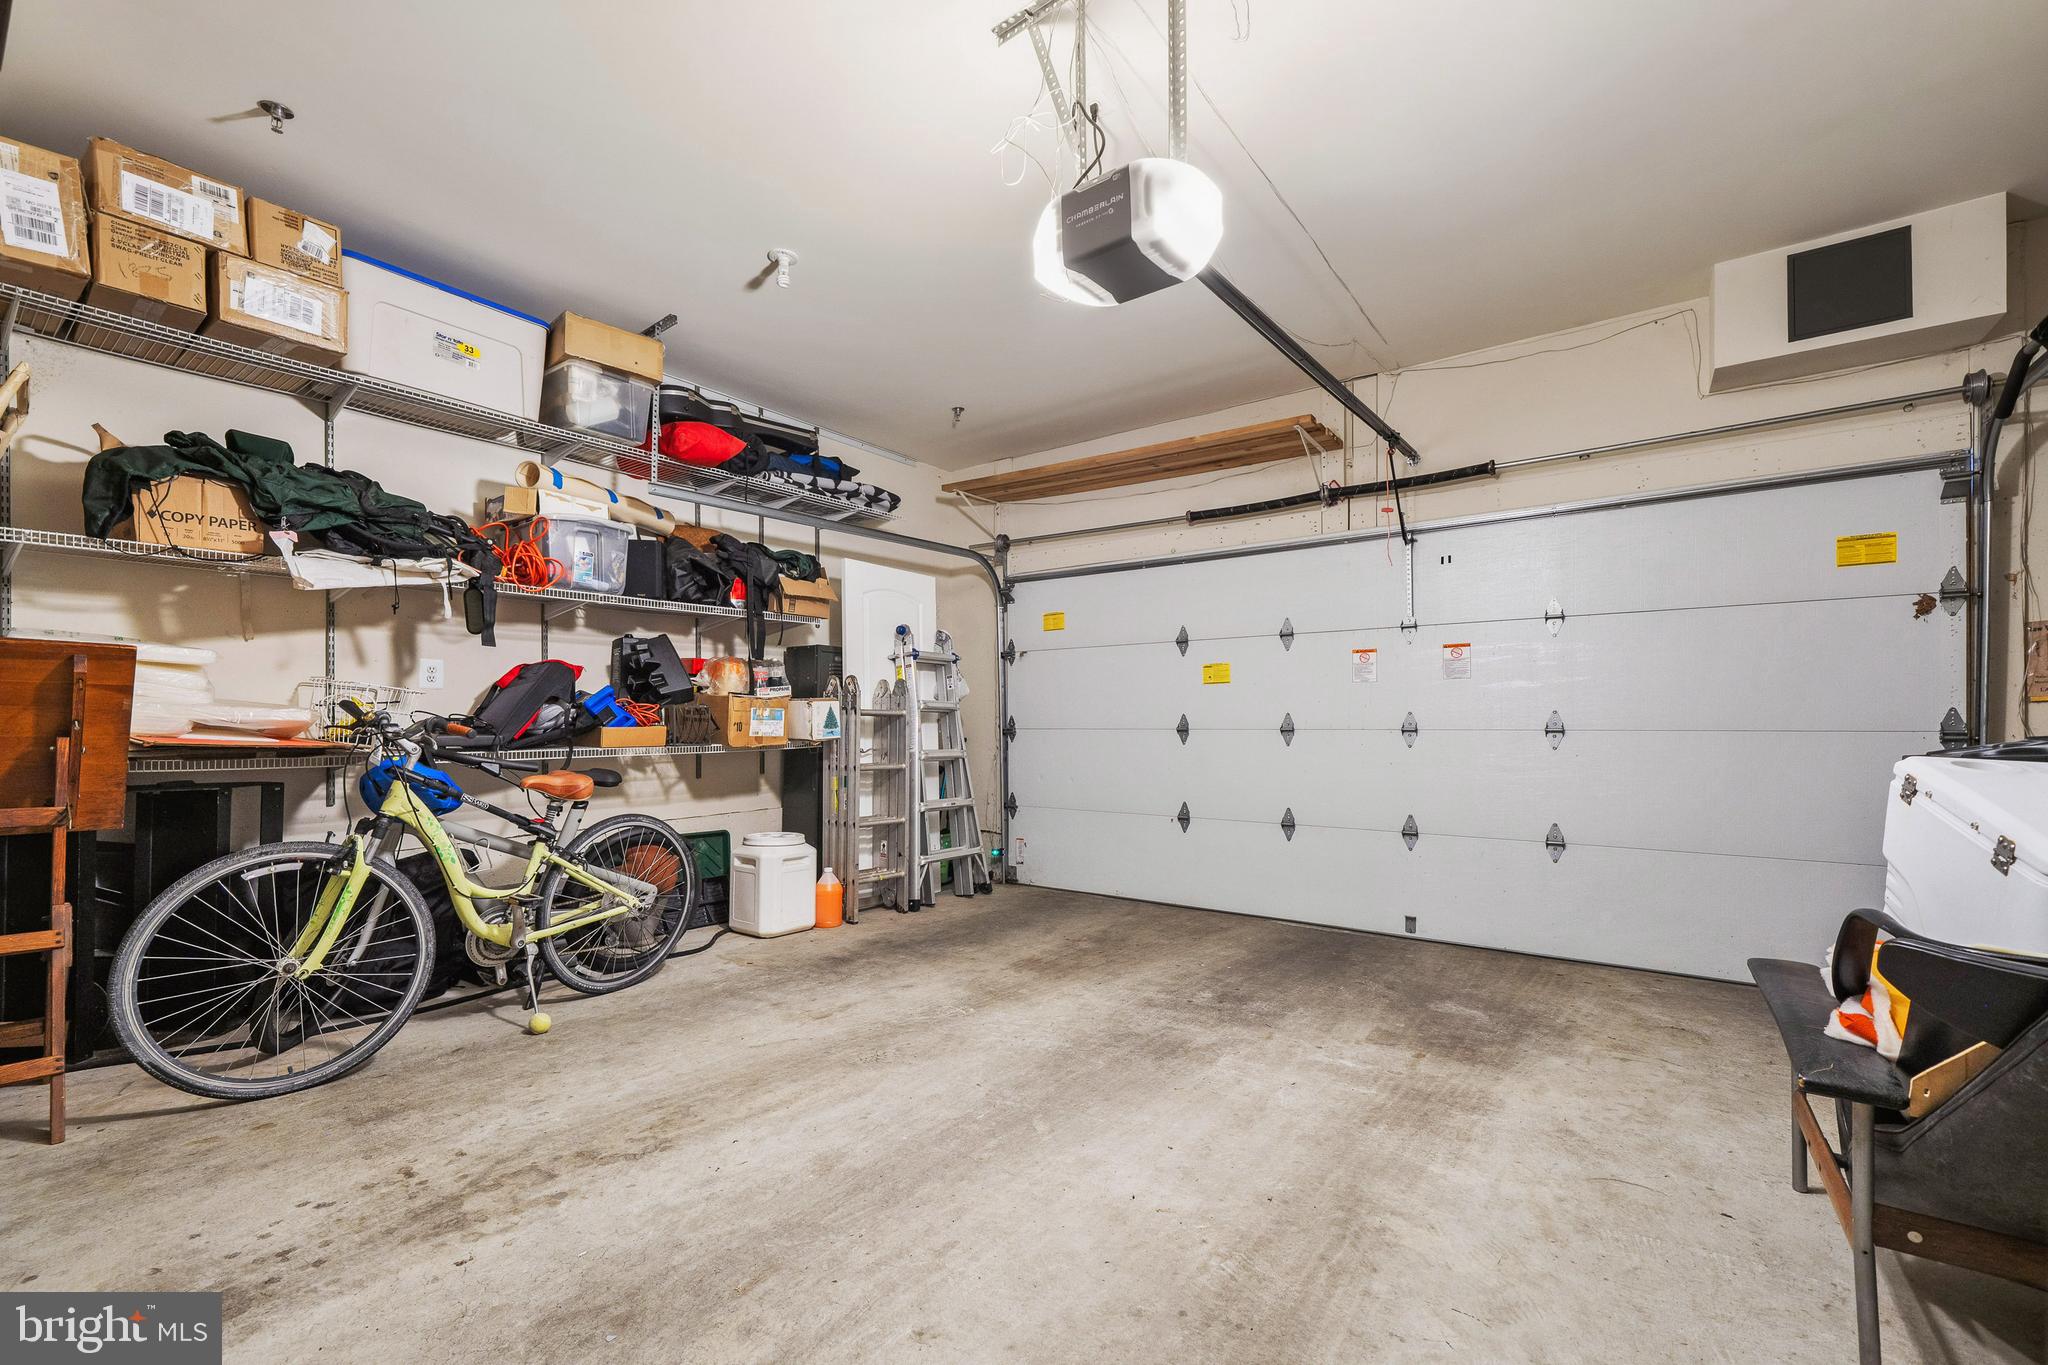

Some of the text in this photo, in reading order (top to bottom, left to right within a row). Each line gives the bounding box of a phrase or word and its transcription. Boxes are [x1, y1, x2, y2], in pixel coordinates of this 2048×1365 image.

[1066, 193, 1124, 224] CHAMBERLAIN
[464, 345, 474, 354] 33
[160, 510, 257, 532] COPY PAPER
